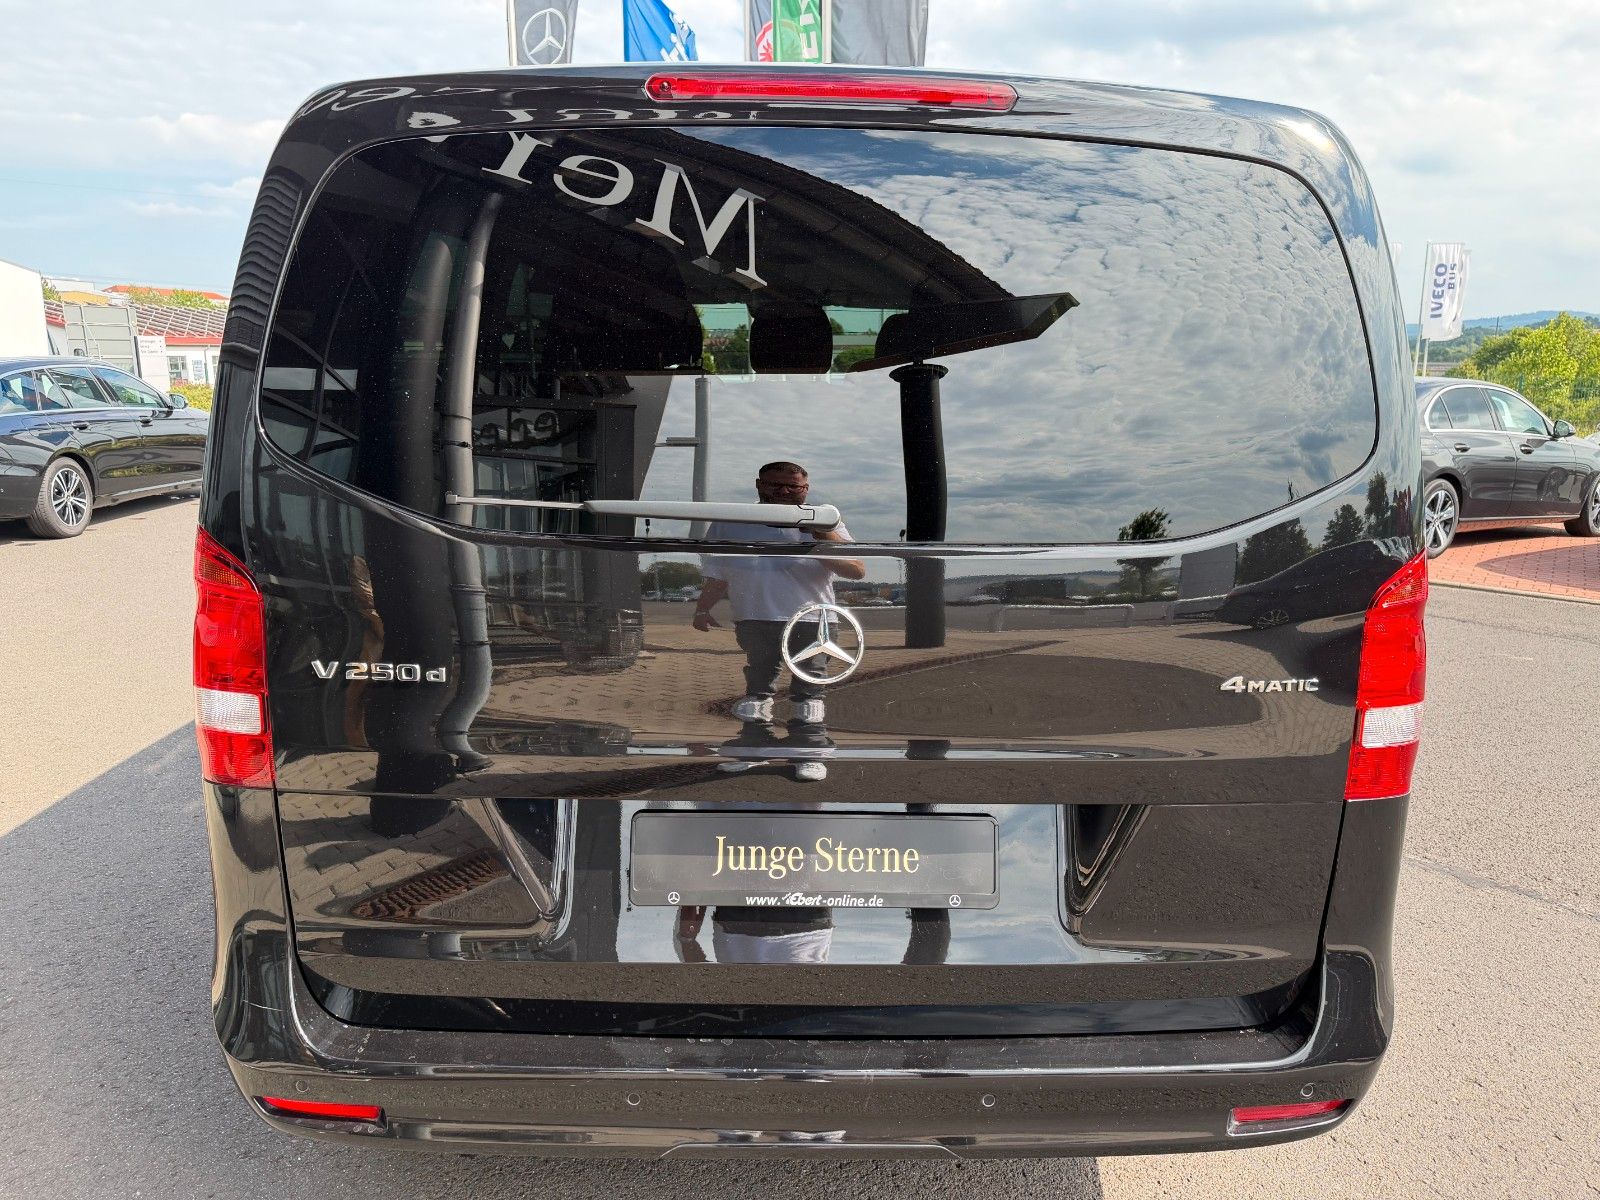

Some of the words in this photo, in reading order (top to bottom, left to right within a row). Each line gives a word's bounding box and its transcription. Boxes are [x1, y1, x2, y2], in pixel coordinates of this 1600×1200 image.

[1448, 263, 1457, 290] BUS
[1430, 263, 1447, 318] IVECO
[345, 662, 420, 682] 250
[1220, 675, 1319, 693] 4MATIC
[712, 835, 804, 879] Junge
[815, 837, 920, 873] Sterne
